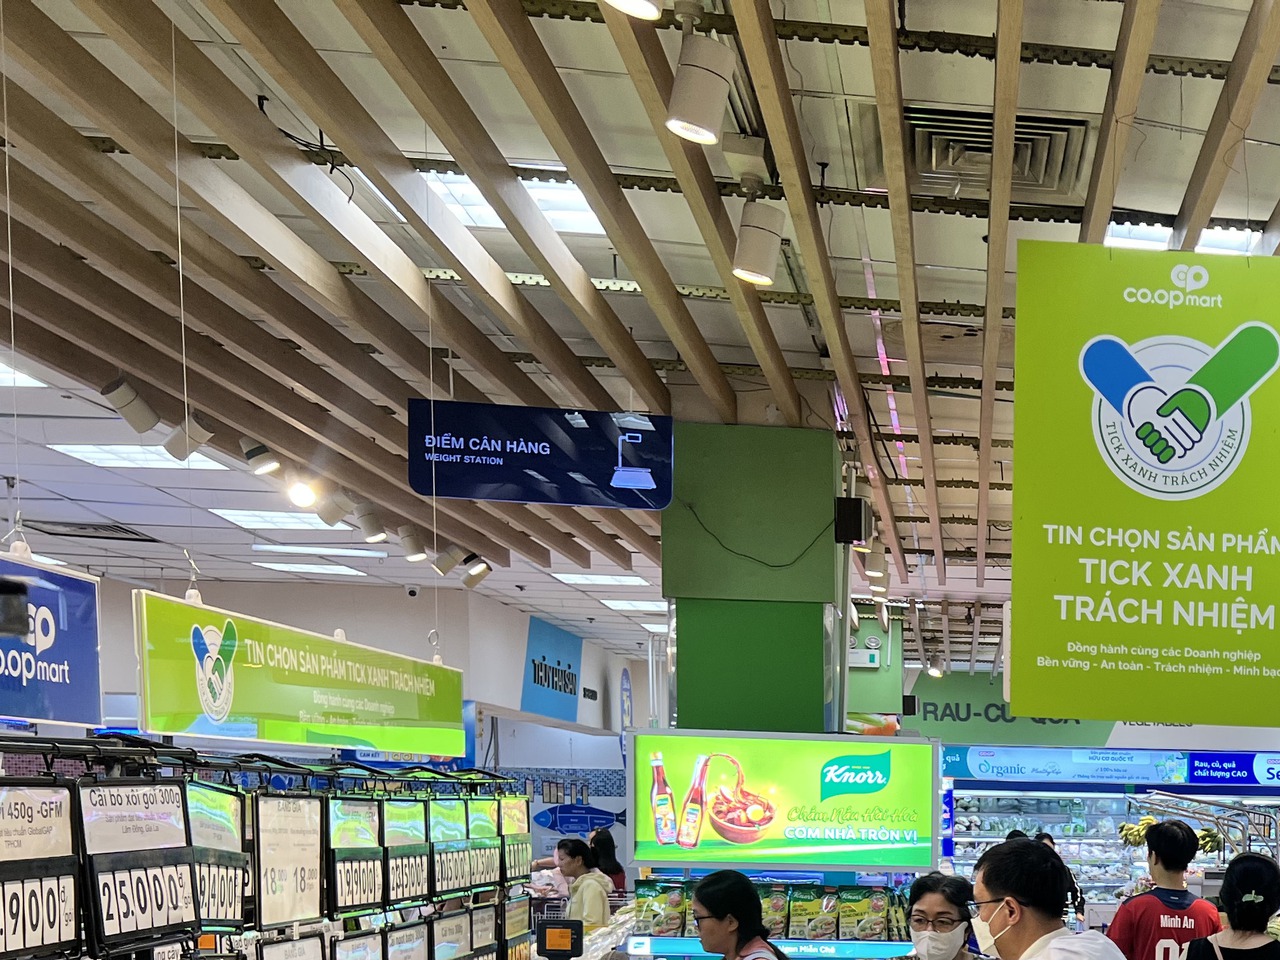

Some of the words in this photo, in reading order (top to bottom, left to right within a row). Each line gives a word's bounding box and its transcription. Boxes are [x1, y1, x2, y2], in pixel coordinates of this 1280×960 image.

[425, 432, 464, 449] ĐIỂM
[469, 436, 501, 452] CÂN
[507, 437, 550, 455] HÀNG
[1106, 421, 1125, 454] TICK
[1122, 453, 1159, 484] XANH
[1161, 469, 1209, 486] TRÁCH
[1208, 428, 1238, 472] NHIỆM
[425, 453, 461, 462] WEIGHT
[463, 455, 503, 465] STATION
[1043, 524, 1082, 546] TIN
[1089, 528, 1159, 553] CHỌN
[1167, 525, 1217, 552] SẢN
[1079, 558, 1152, 587] TICK
[1163, 563, 1253, 591] XANH
[1054, 591, 1163, 624] TRÁCH
[1173, 599, 1275, 634] NHIỆM
[1067, 642, 1097, 656] Đồng
[1100, 643, 1128, 656] hành
[1131, 644, 1159, 659] cùng
[1163, 645, 1181, 657] các
[1184, 646, 1219, 659] Doanh
[1223, 648, 1261, 663] nghiệp
[245, 639, 265, 664] TIN
[267, 644, 297, 675] CHỌN
[300, 645, 319, 675] SẢN
[321, 651, 346, 680] PHẨM
[347, 662, 366, 683] TICK
[368, 668, 389, 688] XANH
[390, 668, 414, 692] TRÁCH
[414, 674, 435, 700] NHIỆM
[1037, 656, 1057, 668] Bền
[1061, 656, 1090, 671] vững
[1100, 659, 1118, 670] An
[1121, 659, 1143, 671] toàn
[1154, 661, 1184, 674] Trách
[1187, 662, 1222, 676] nhiệm
[1233, 664, 1261, 676] Minh
[823, 764, 886, 785] Knorr
[979, 760, 1026, 777] Organic
[1231, 770, 1247, 778] CAO
[160, 789, 181, 808] 300g
[8, 801, 33, 823] 450g
[785, 826, 821, 840] CƠM
[824, 825, 856, 840] NHÀ
[859, 827, 898, 844] TRÒN
[903, 829, 917, 845] VỊ
[102, 875, 179, 921] 25.000
[1160, 915, 1181, 928] Minh
[1183, 916, 1194, 929] An
